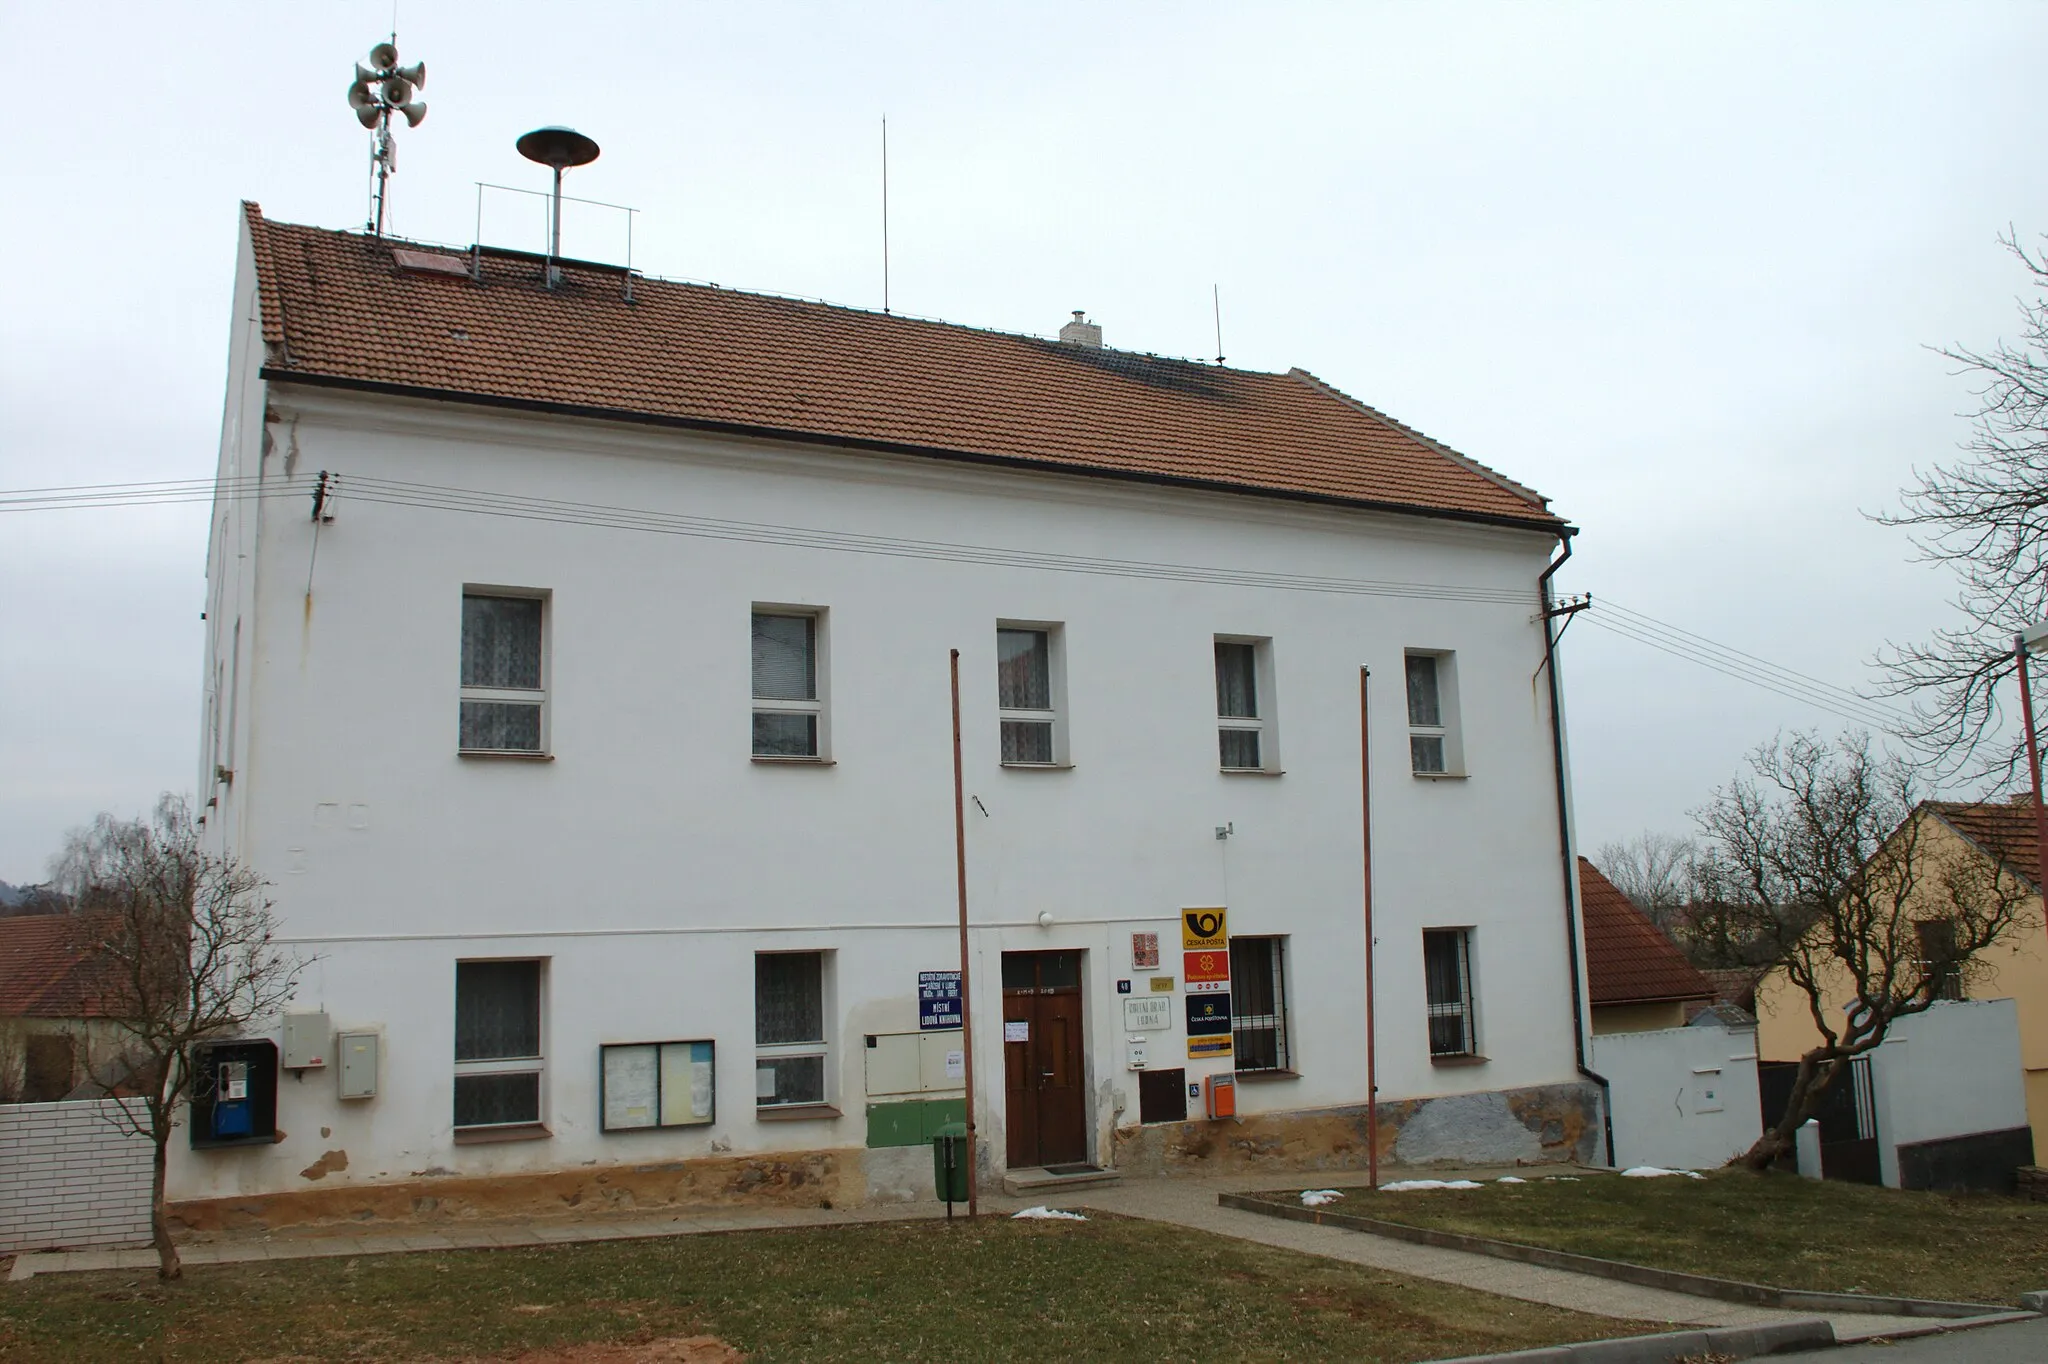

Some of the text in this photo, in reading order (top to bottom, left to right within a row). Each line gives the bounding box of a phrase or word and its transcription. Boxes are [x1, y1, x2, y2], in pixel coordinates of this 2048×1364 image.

[933, 1001, 950, 1012] MÍSTNÍ
[922, 1013, 961, 1025] LIDOVÁ KNIHOVNA
